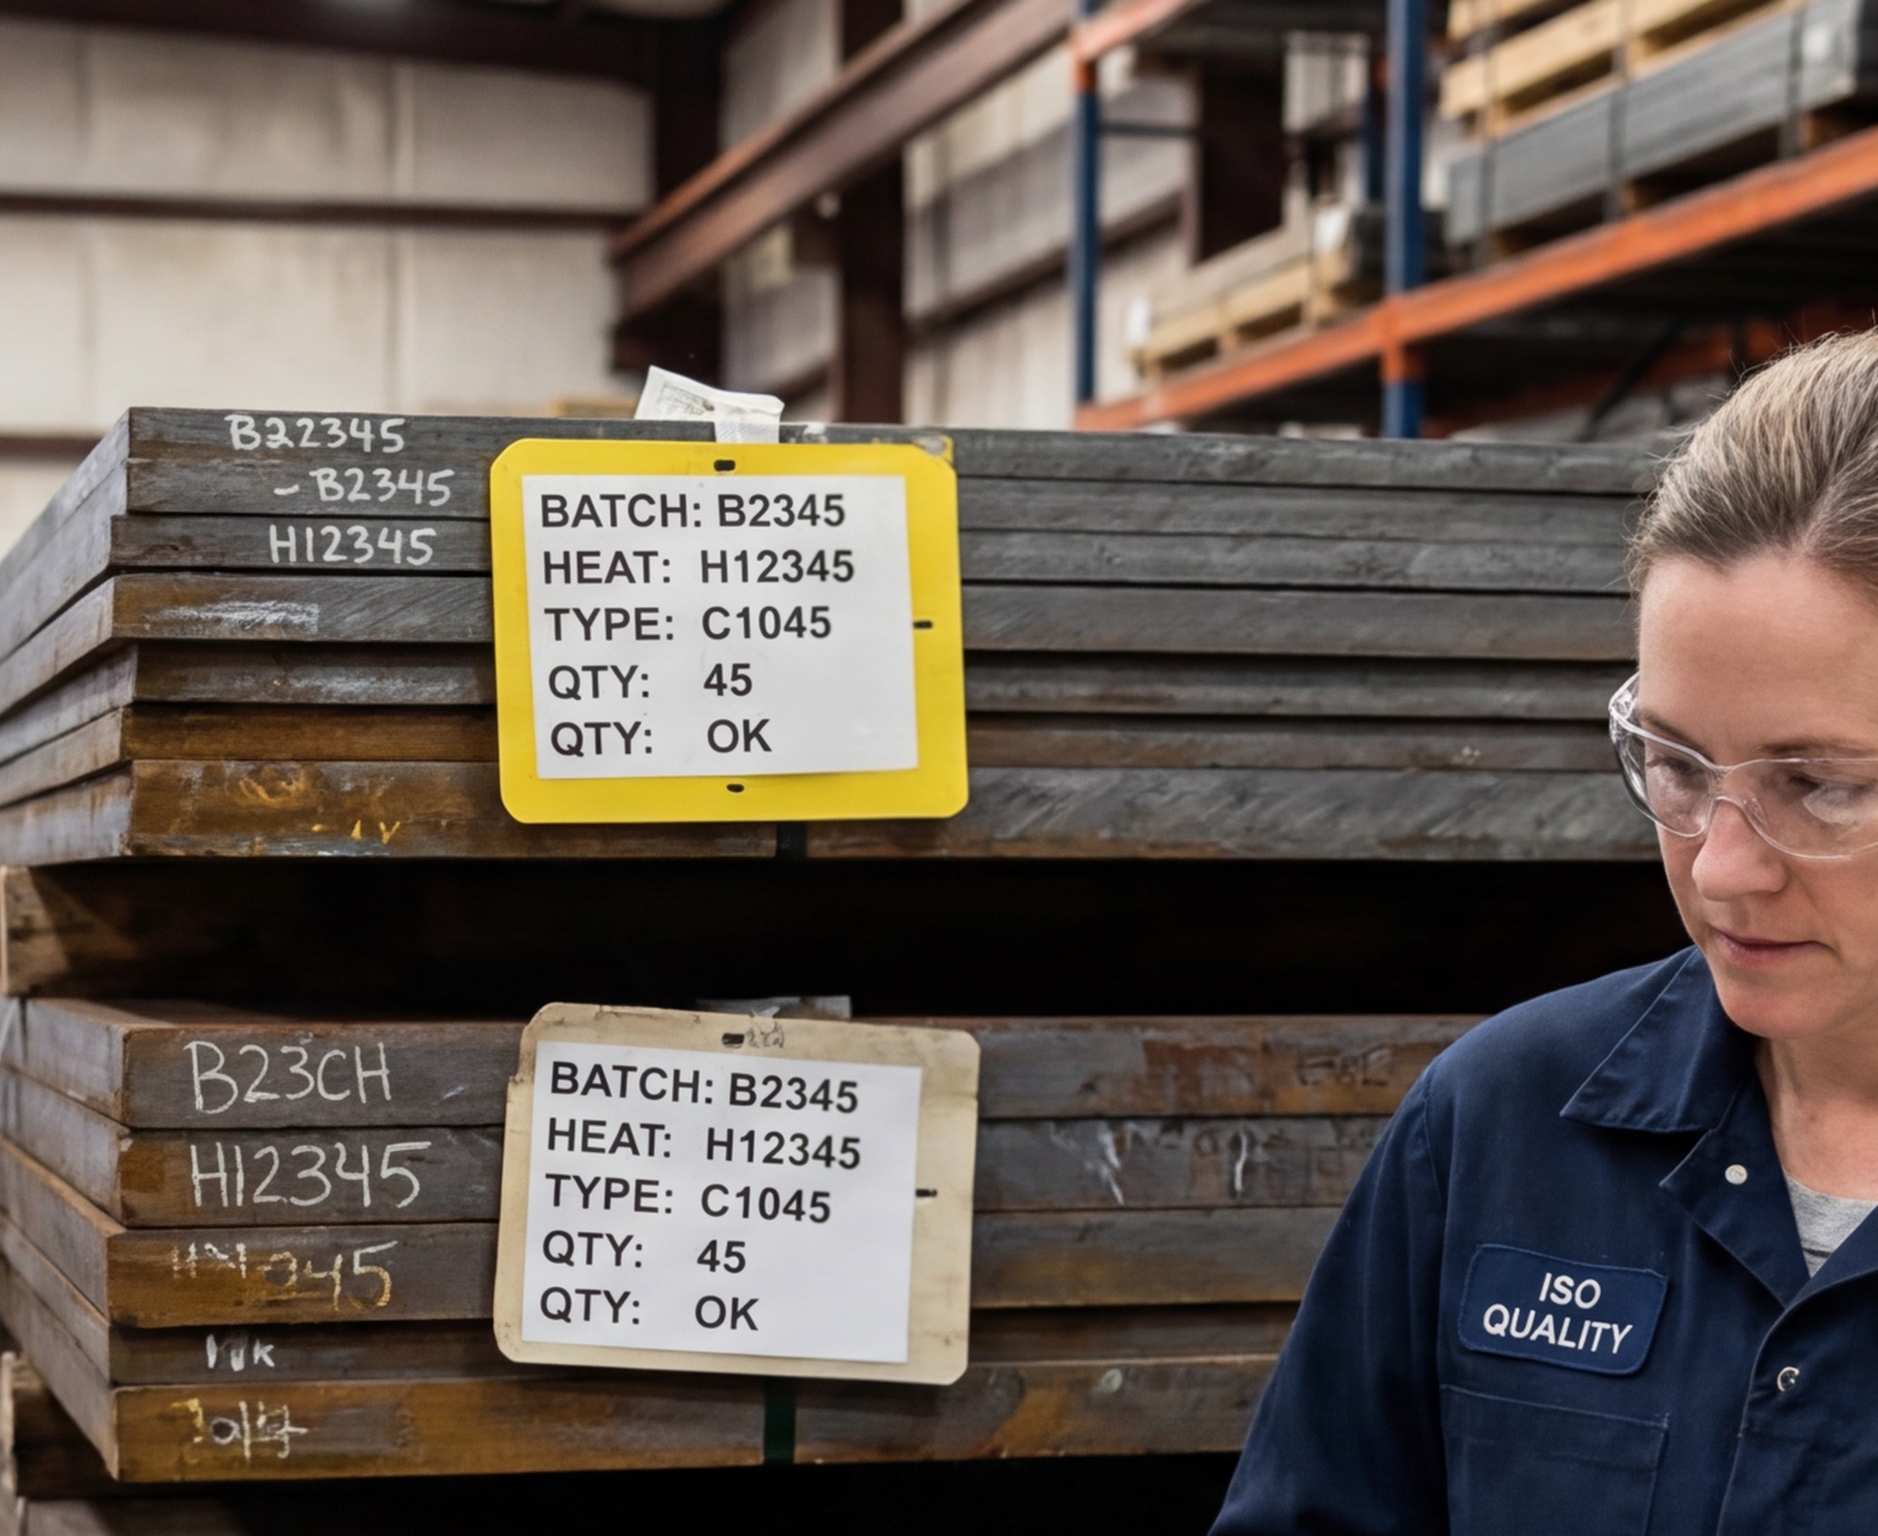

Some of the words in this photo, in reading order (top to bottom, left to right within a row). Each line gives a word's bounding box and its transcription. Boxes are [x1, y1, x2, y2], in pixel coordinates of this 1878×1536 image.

[225, 414, 406, 453] B22345
[541, 493, 702, 528] BATCH:
[717, 493, 845, 528] B2345
[269, 524, 437, 566] H12345
[543, 550, 671, 585] HEAT:
[700, 549, 855, 584] H12345
[543, 607, 674, 642] TYPE:
[702, 605, 832, 640] C1045
[548, 664, 649, 701] QTY:
[703, 662, 753, 697] 45
[550, 721, 652, 758] QTY:
[707, 718, 772, 754] OK
[185, 1041, 391, 1114] B23CH
[551, 1060, 713, 1105] BATCH:
[729, 1072, 858, 1114] B2345
[547, 1117, 671, 1158] HEAT:
[706, 1127, 861, 1170] H12345
[190, 1141, 432, 1207] H12345
[545, 1173, 673, 1214] TYPE:
[701, 1183, 831, 1224] C1045
[542, 1229, 643, 1268] QTY:
[696, 1239, 746, 1274] 45
[540, 1286, 640, 1325] QTY:
[695, 1295, 759, 1331] OK
[1539, 1272, 1601, 1309] ISO
[1482, 1303, 1634, 1355] QUALITY
